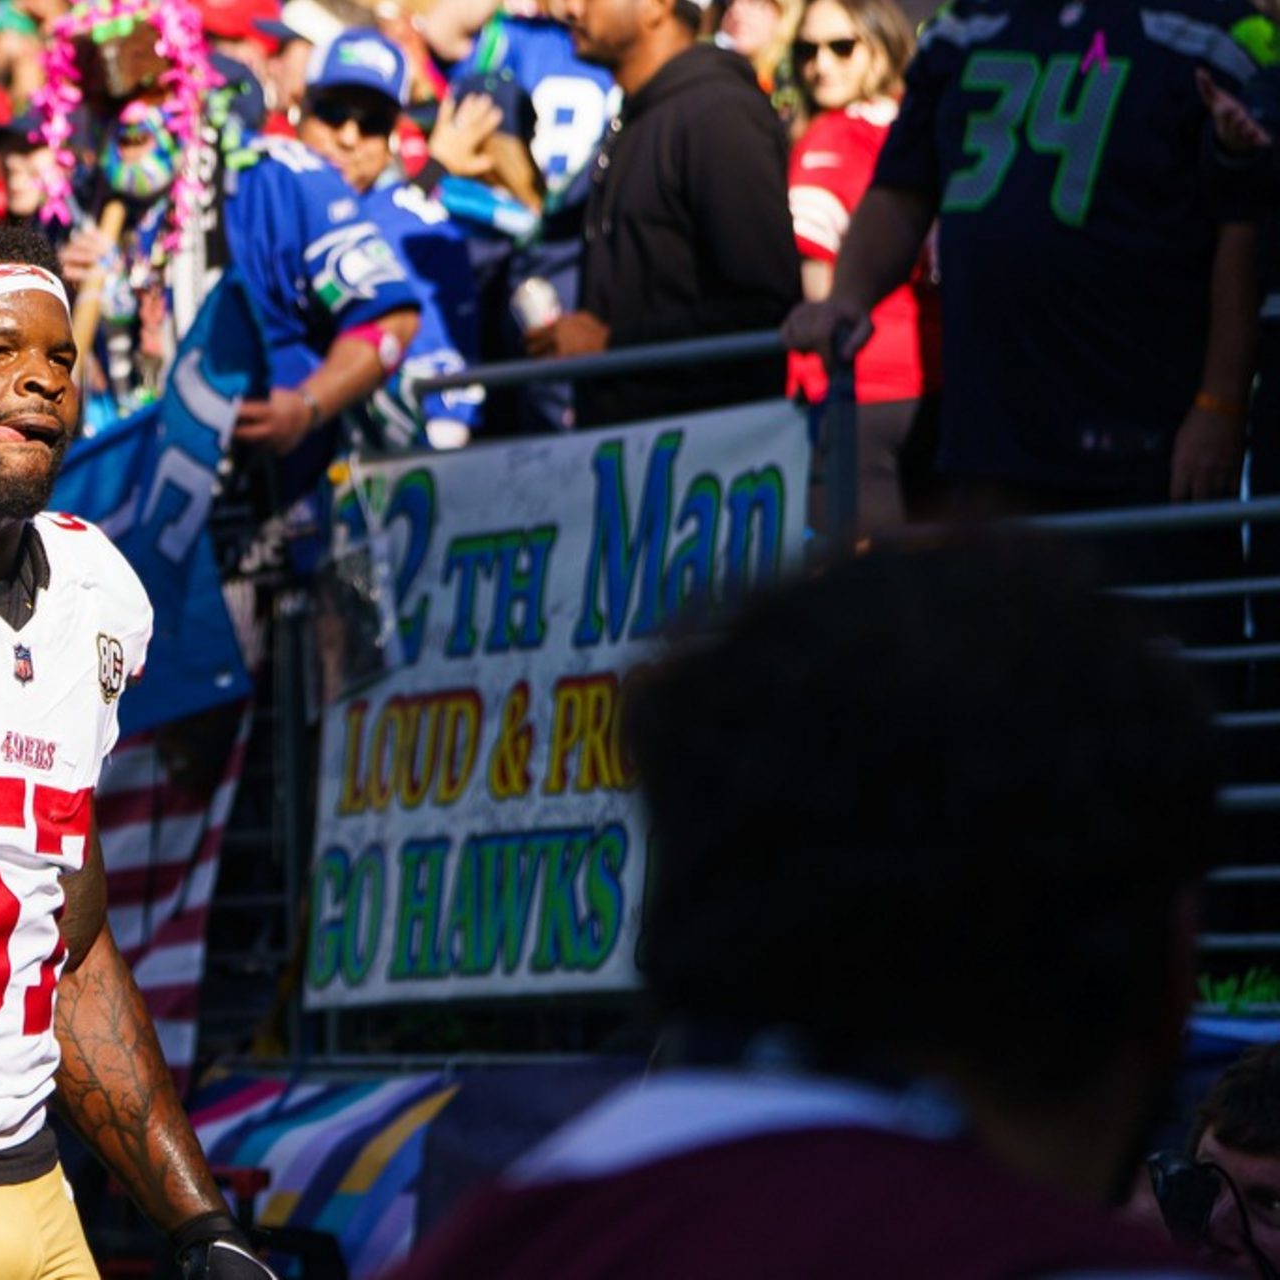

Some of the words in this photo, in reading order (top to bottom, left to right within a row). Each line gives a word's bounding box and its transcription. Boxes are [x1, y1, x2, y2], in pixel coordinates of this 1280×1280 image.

[942, 50, 1132, 228] 34
[573, 430, 787, 648] Man
[1, 731, 57, 771] 49ERS
[338, 686, 483, 817] LOUD
[488, 679, 532, 800] &
[543, 671, 641, 796] PRO
[305, 842, 386, 990] GO
[386, 822, 629, 983] HAWKS
